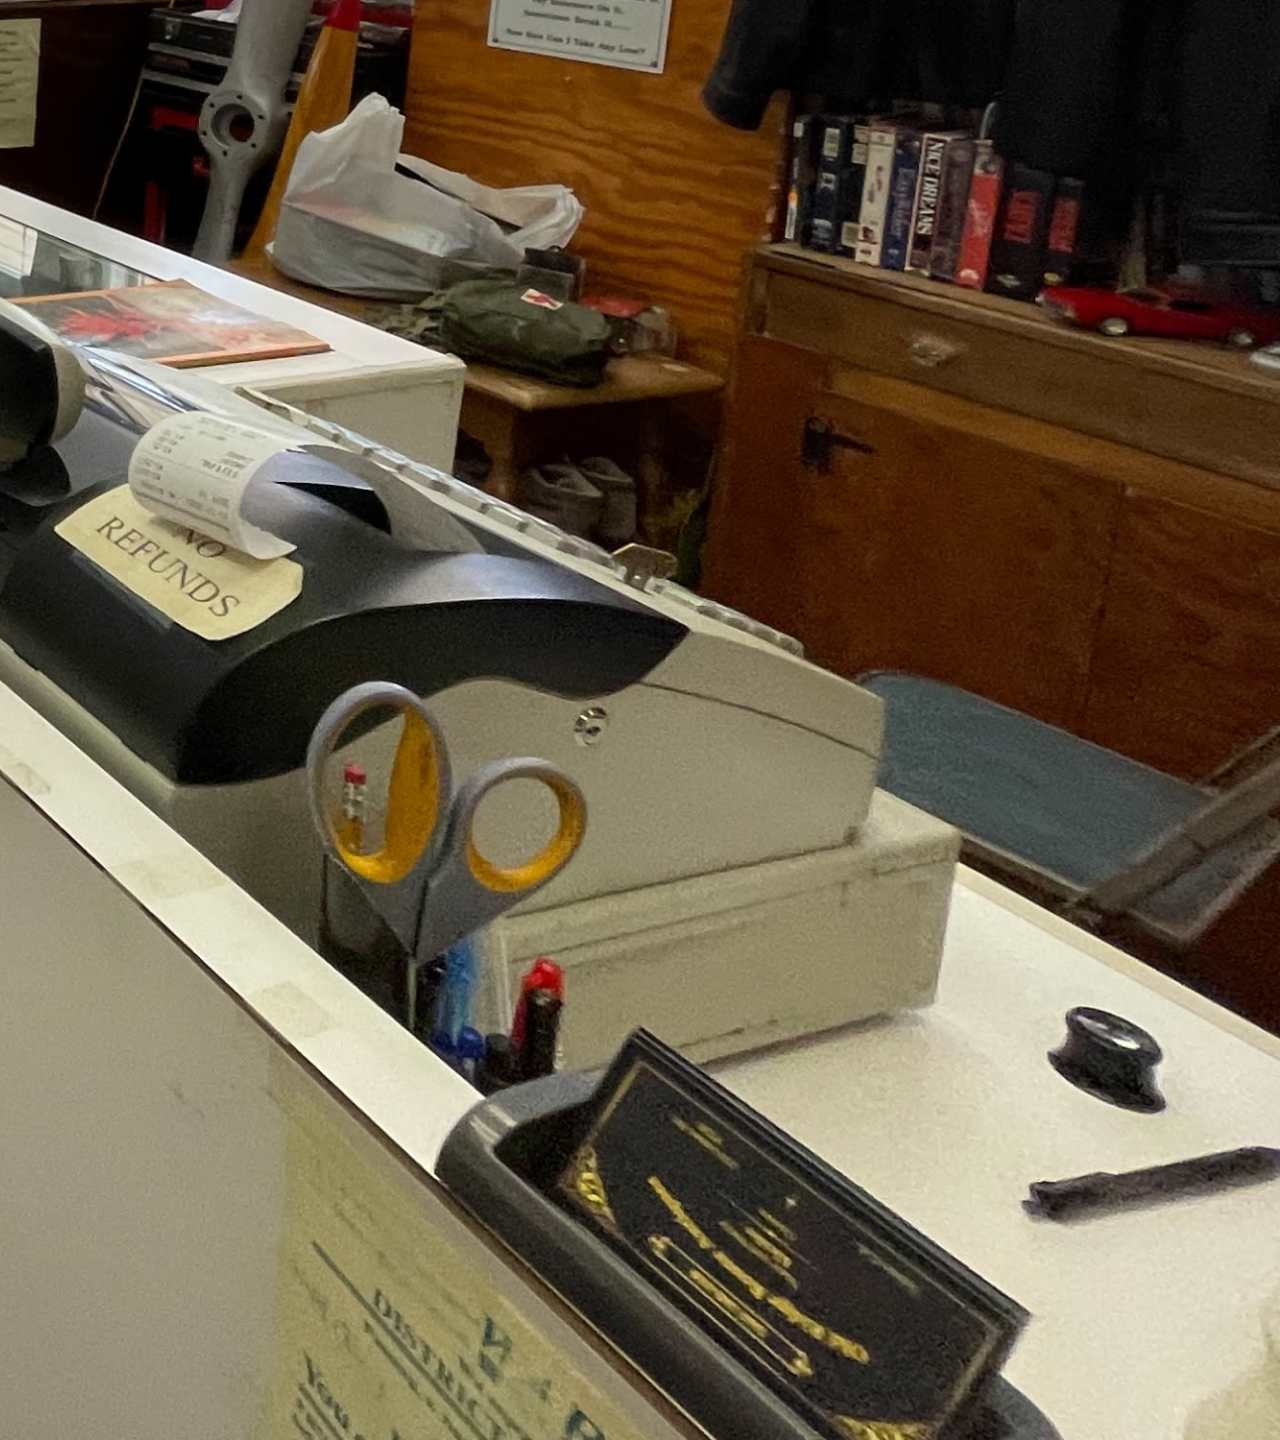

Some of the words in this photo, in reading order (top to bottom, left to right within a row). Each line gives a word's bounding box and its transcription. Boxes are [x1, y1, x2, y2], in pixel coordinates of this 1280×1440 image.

[925, 142, 944, 176] NICE
[916, 176, 939, 235] DREAMS
[96, 516, 240, 617] REFUNDS
